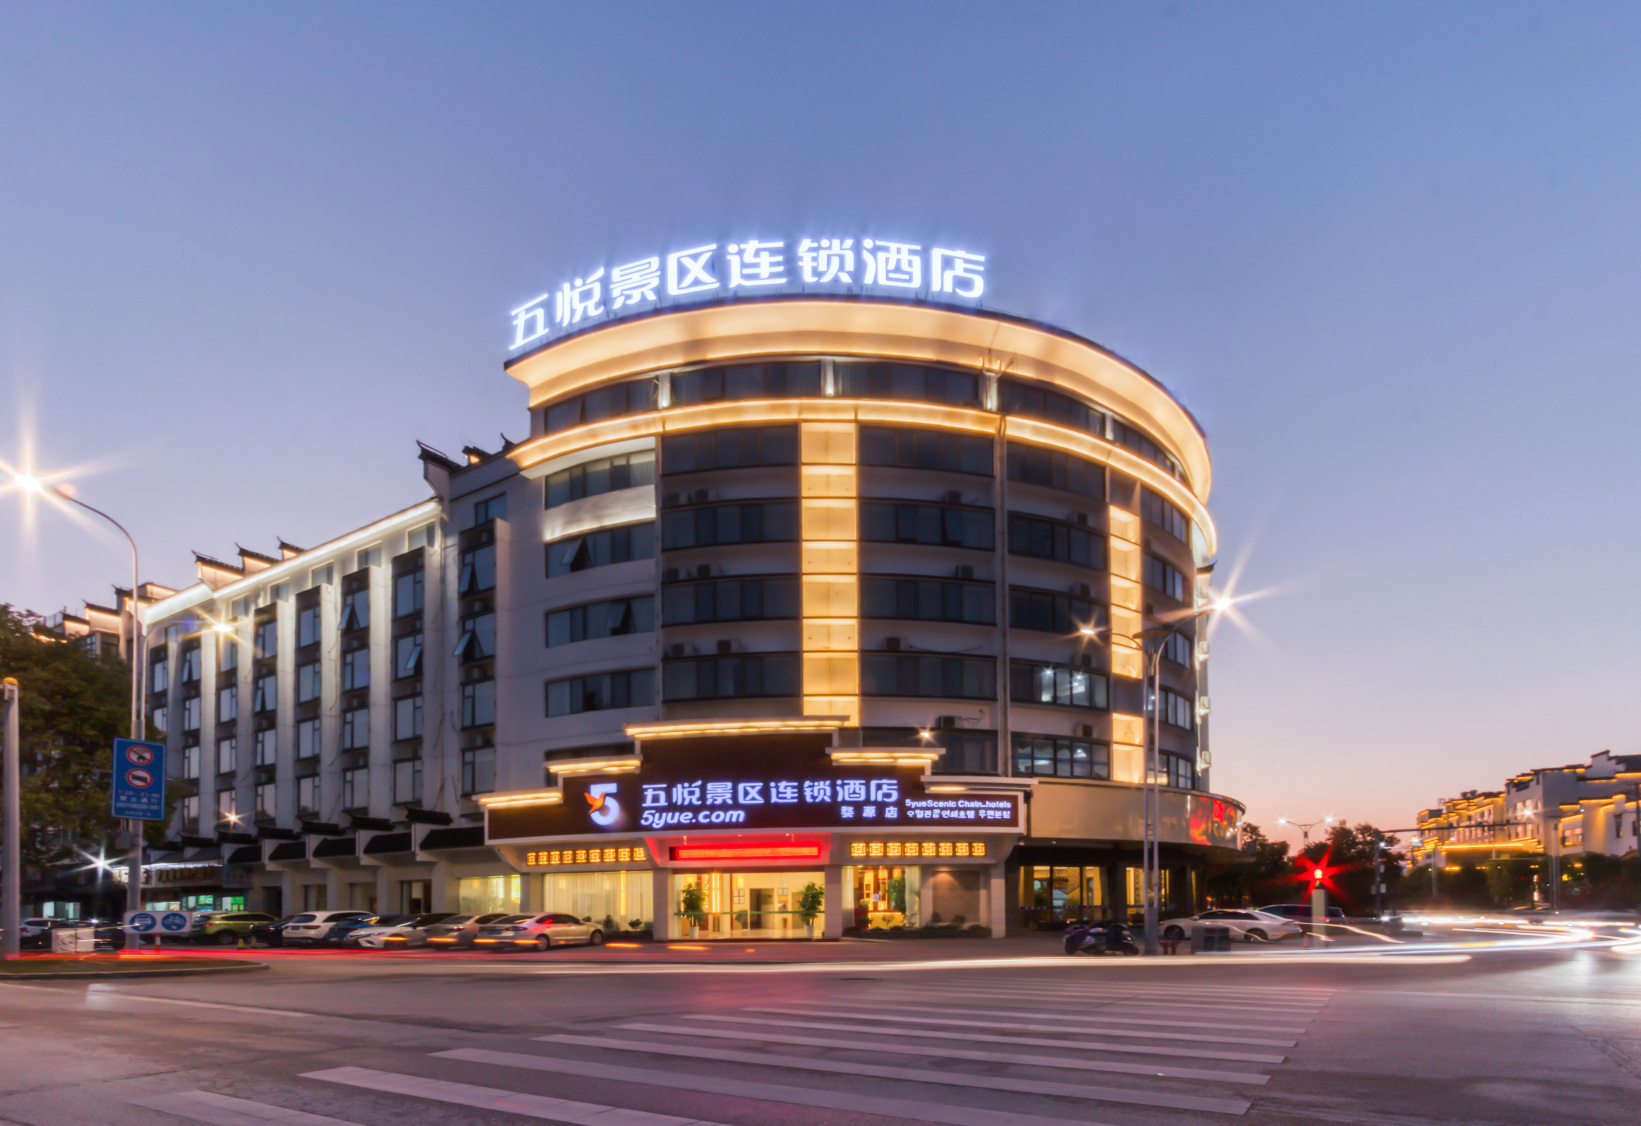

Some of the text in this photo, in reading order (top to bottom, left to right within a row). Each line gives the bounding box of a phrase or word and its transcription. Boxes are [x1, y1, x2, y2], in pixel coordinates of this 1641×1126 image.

[508, 238, 986, 351] 五悦景区连锁酒店
[641, 779, 898, 806] 五悦景区连锁酒店
[640, 808, 746, 829] 5yue.com
